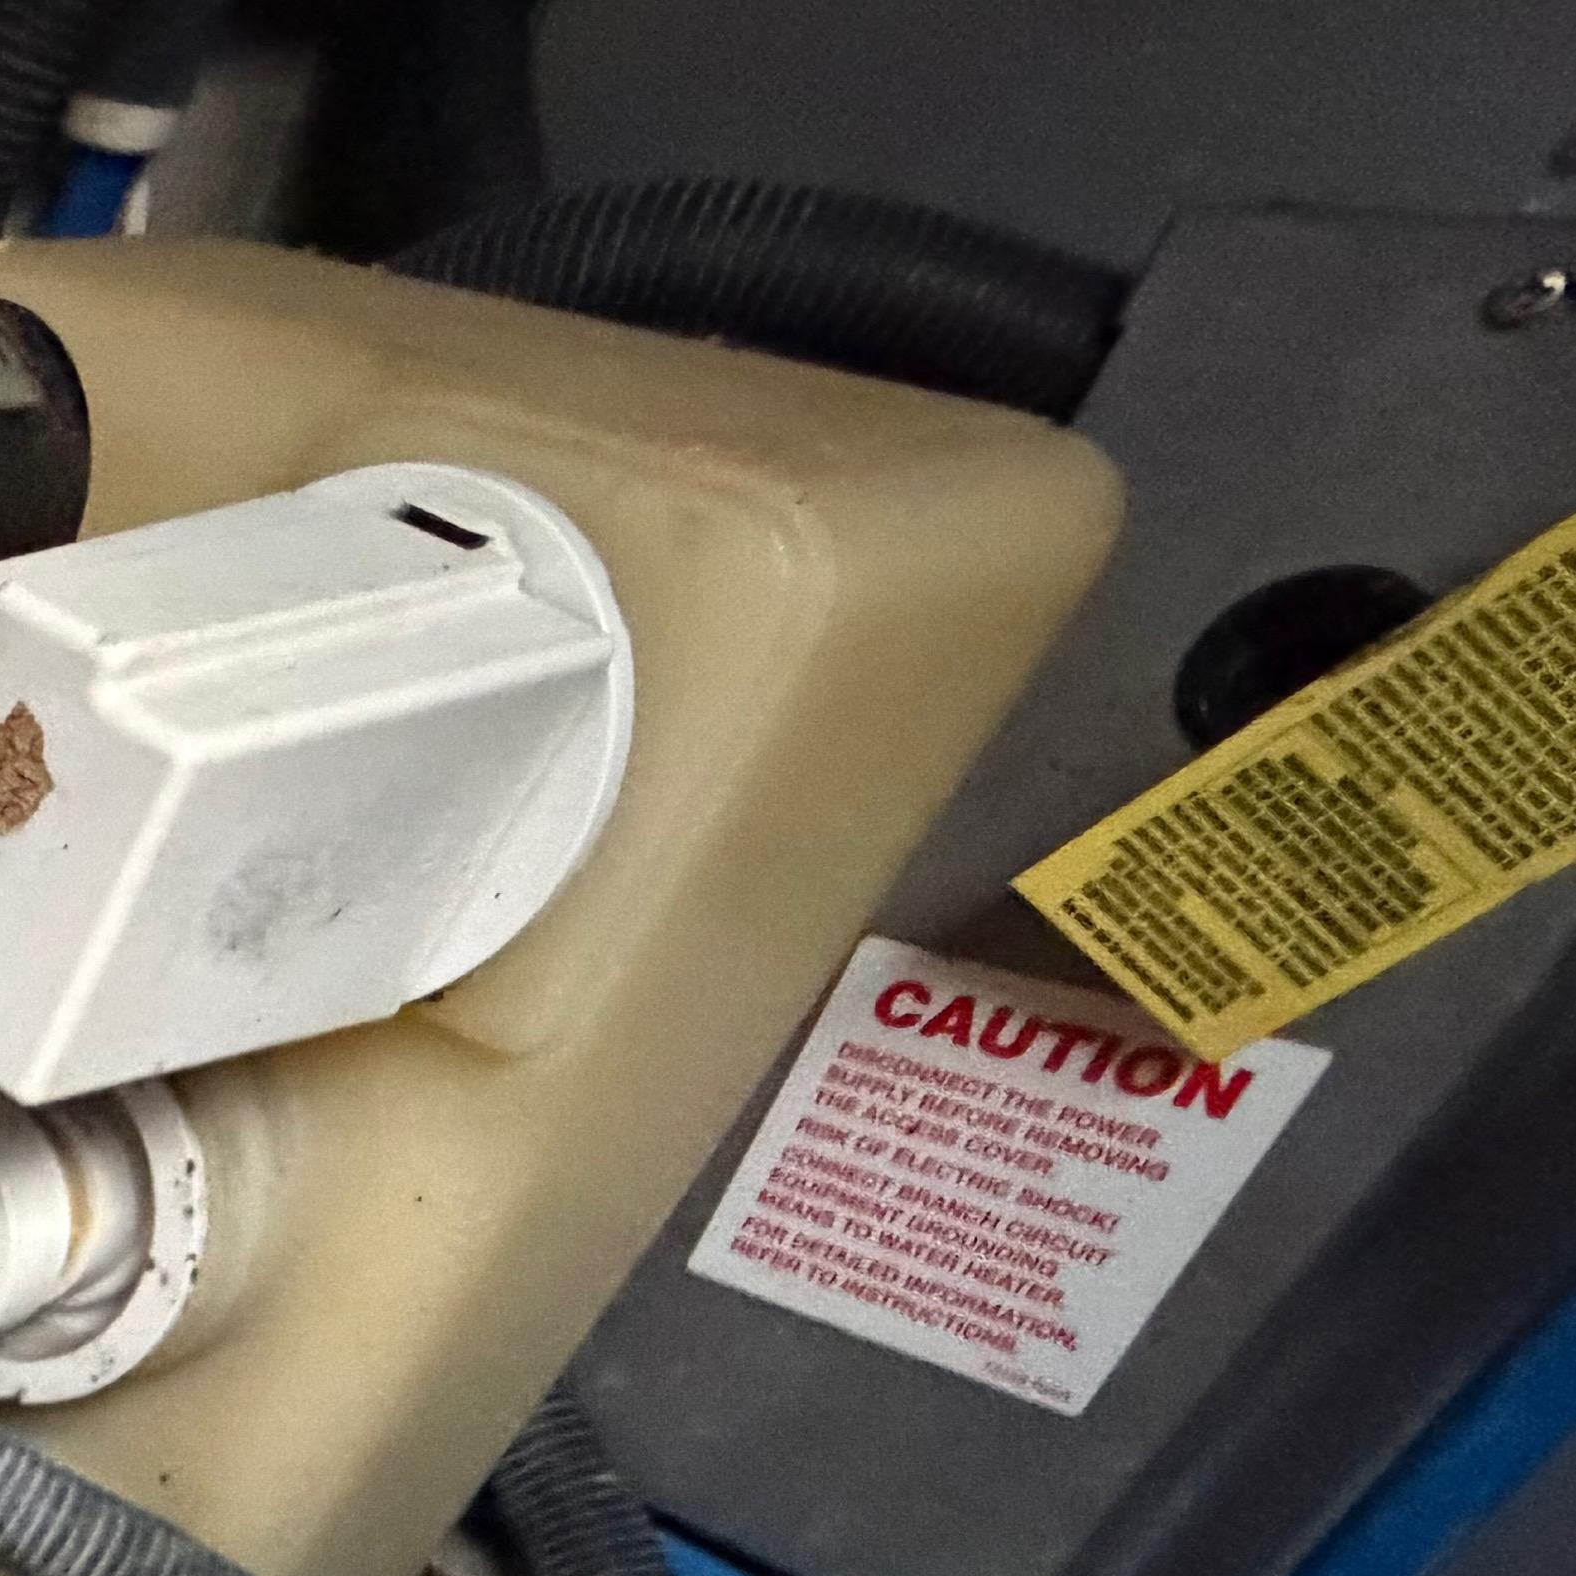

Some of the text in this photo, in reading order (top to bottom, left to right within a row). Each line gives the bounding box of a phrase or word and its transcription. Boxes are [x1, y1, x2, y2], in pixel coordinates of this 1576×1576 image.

[874, 979, 1254, 1119] CAUTION
[811, 1088, 860, 1116] THE
[996, 1086, 1056, 1118] THE
[1054, 1103, 1164, 1150] POWER
[852, 1134, 888, 1158] OF
[1021, 1123, 1173, 1183] REMOVING
[741, 1215, 789, 1244] FOR
[789, 1232, 902, 1284] DETAILED
[841, 1217, 875, 1241] TO
[874, 1229, 961, 1271] WATER
[806, 1264, 839, 1287] TO
